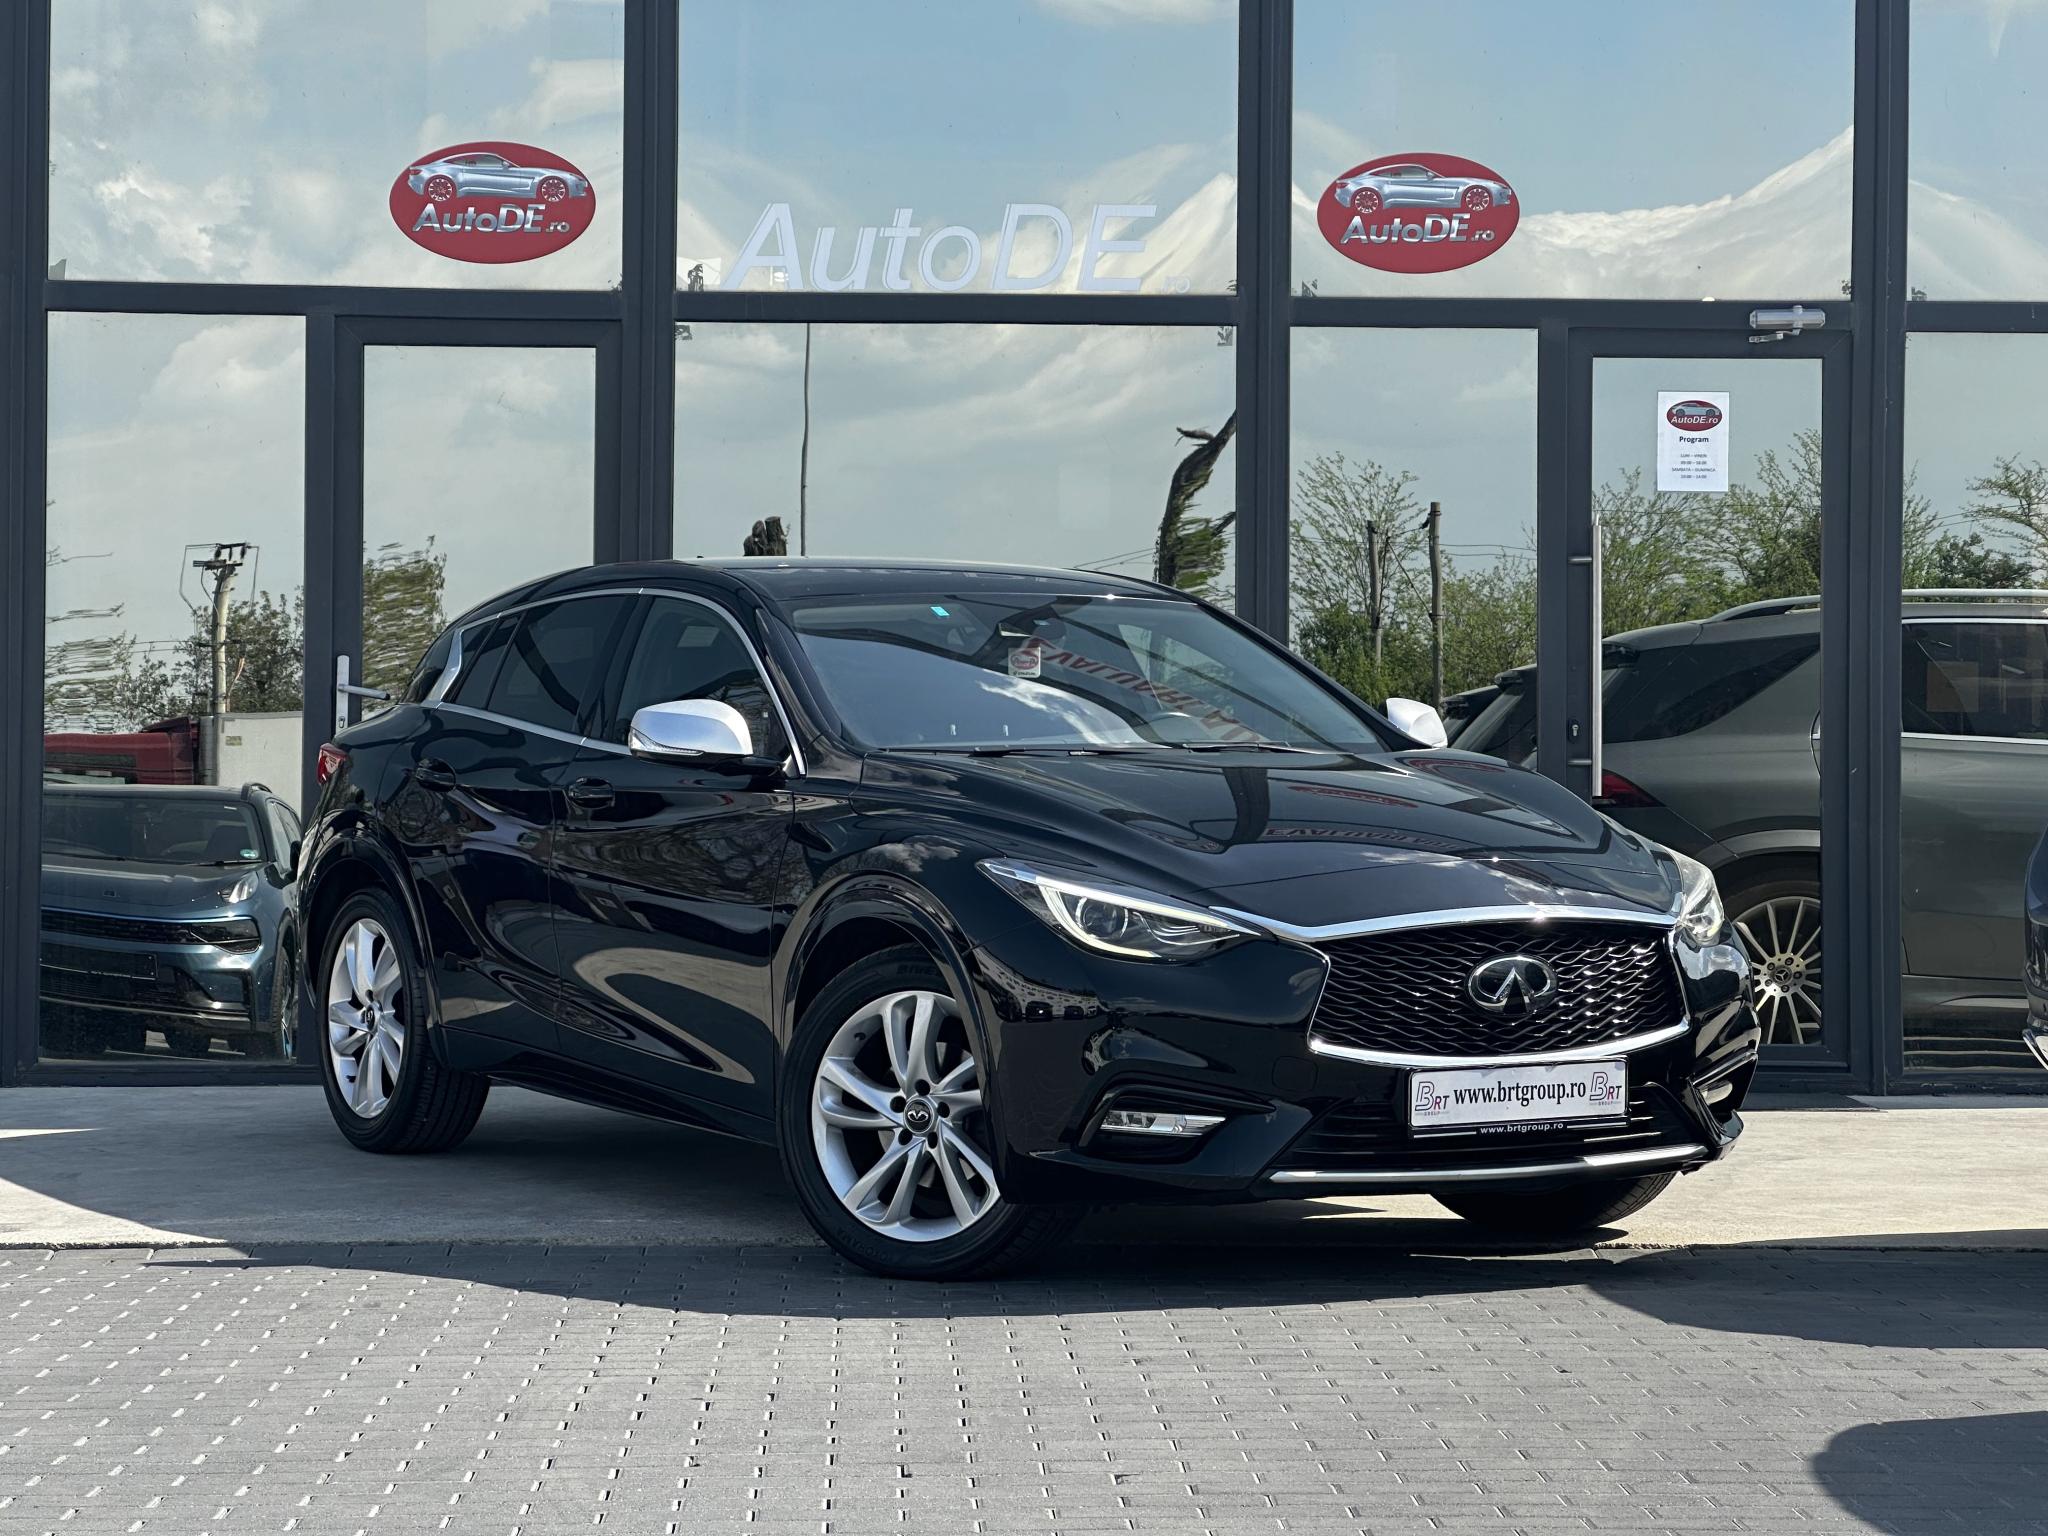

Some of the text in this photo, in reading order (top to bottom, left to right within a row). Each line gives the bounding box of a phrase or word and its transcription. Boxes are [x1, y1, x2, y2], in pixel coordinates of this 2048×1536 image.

[1670, 415, 1719, 424] AutoDE.ro
[1679, 436, 1709, 444] Program
[1453, 1081, 1587, 1107] www.brtgroup.ro
[1480, 1122, 1564, 1134] www.brtgroup.ro
